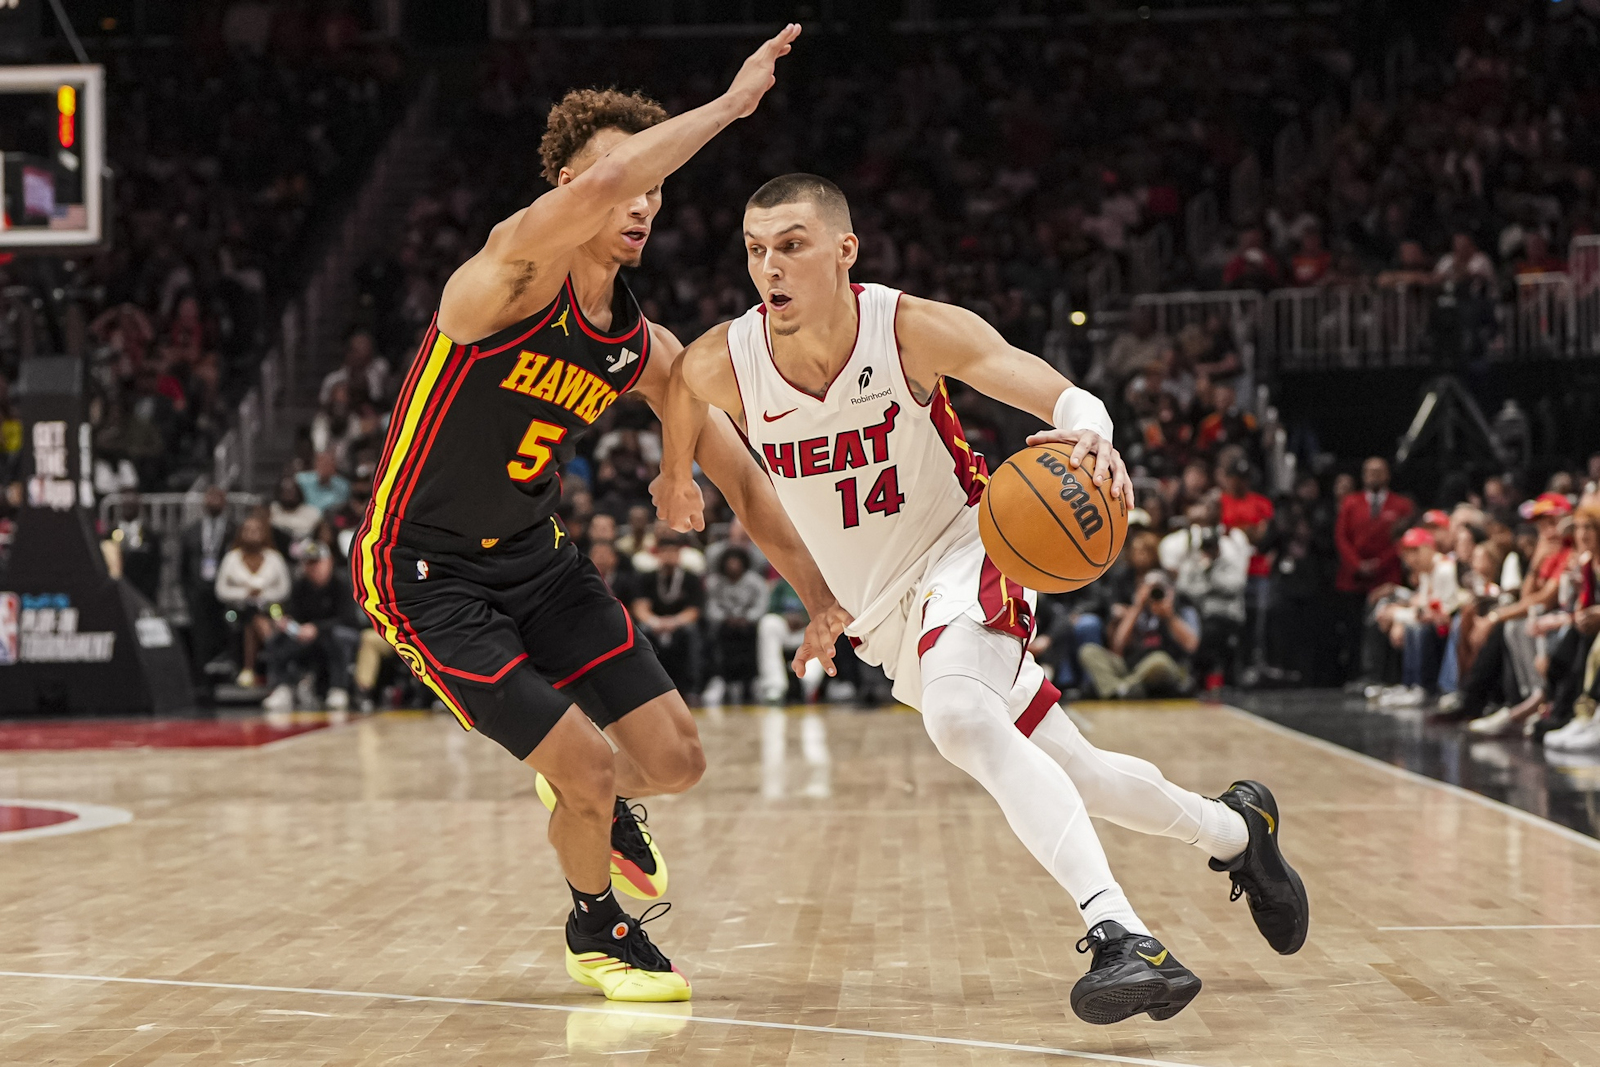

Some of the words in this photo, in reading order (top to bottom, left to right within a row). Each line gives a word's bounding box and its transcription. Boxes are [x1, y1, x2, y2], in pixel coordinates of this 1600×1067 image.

[850, 387, 893, 405] Robinhood
[506, 418, 567, 483] 5
[761, 400, 901, 479] HEAT
[835, 464, 906, 529] 14
[1035, 451, 1104, 541] Wilson
